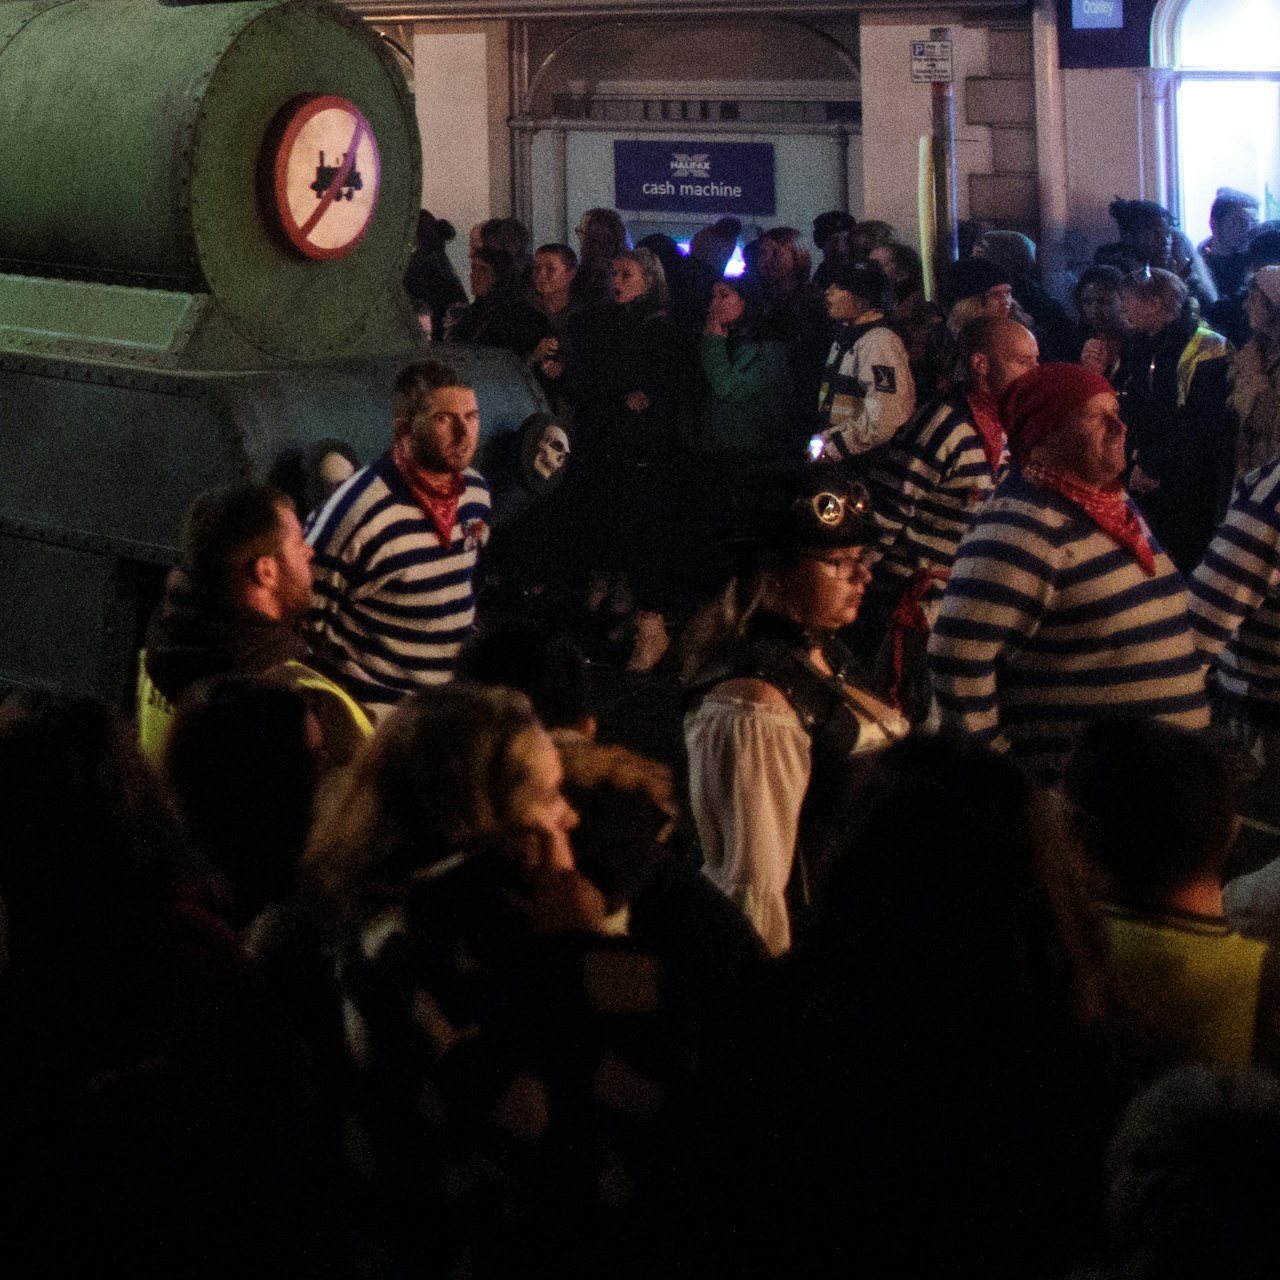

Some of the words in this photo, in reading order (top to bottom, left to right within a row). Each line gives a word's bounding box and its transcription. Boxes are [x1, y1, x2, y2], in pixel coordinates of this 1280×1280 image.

[670, 161, 710, 170] HALIFAX
[642, 181, 675, 195] cash
[680, 182, 741, 197] machine
